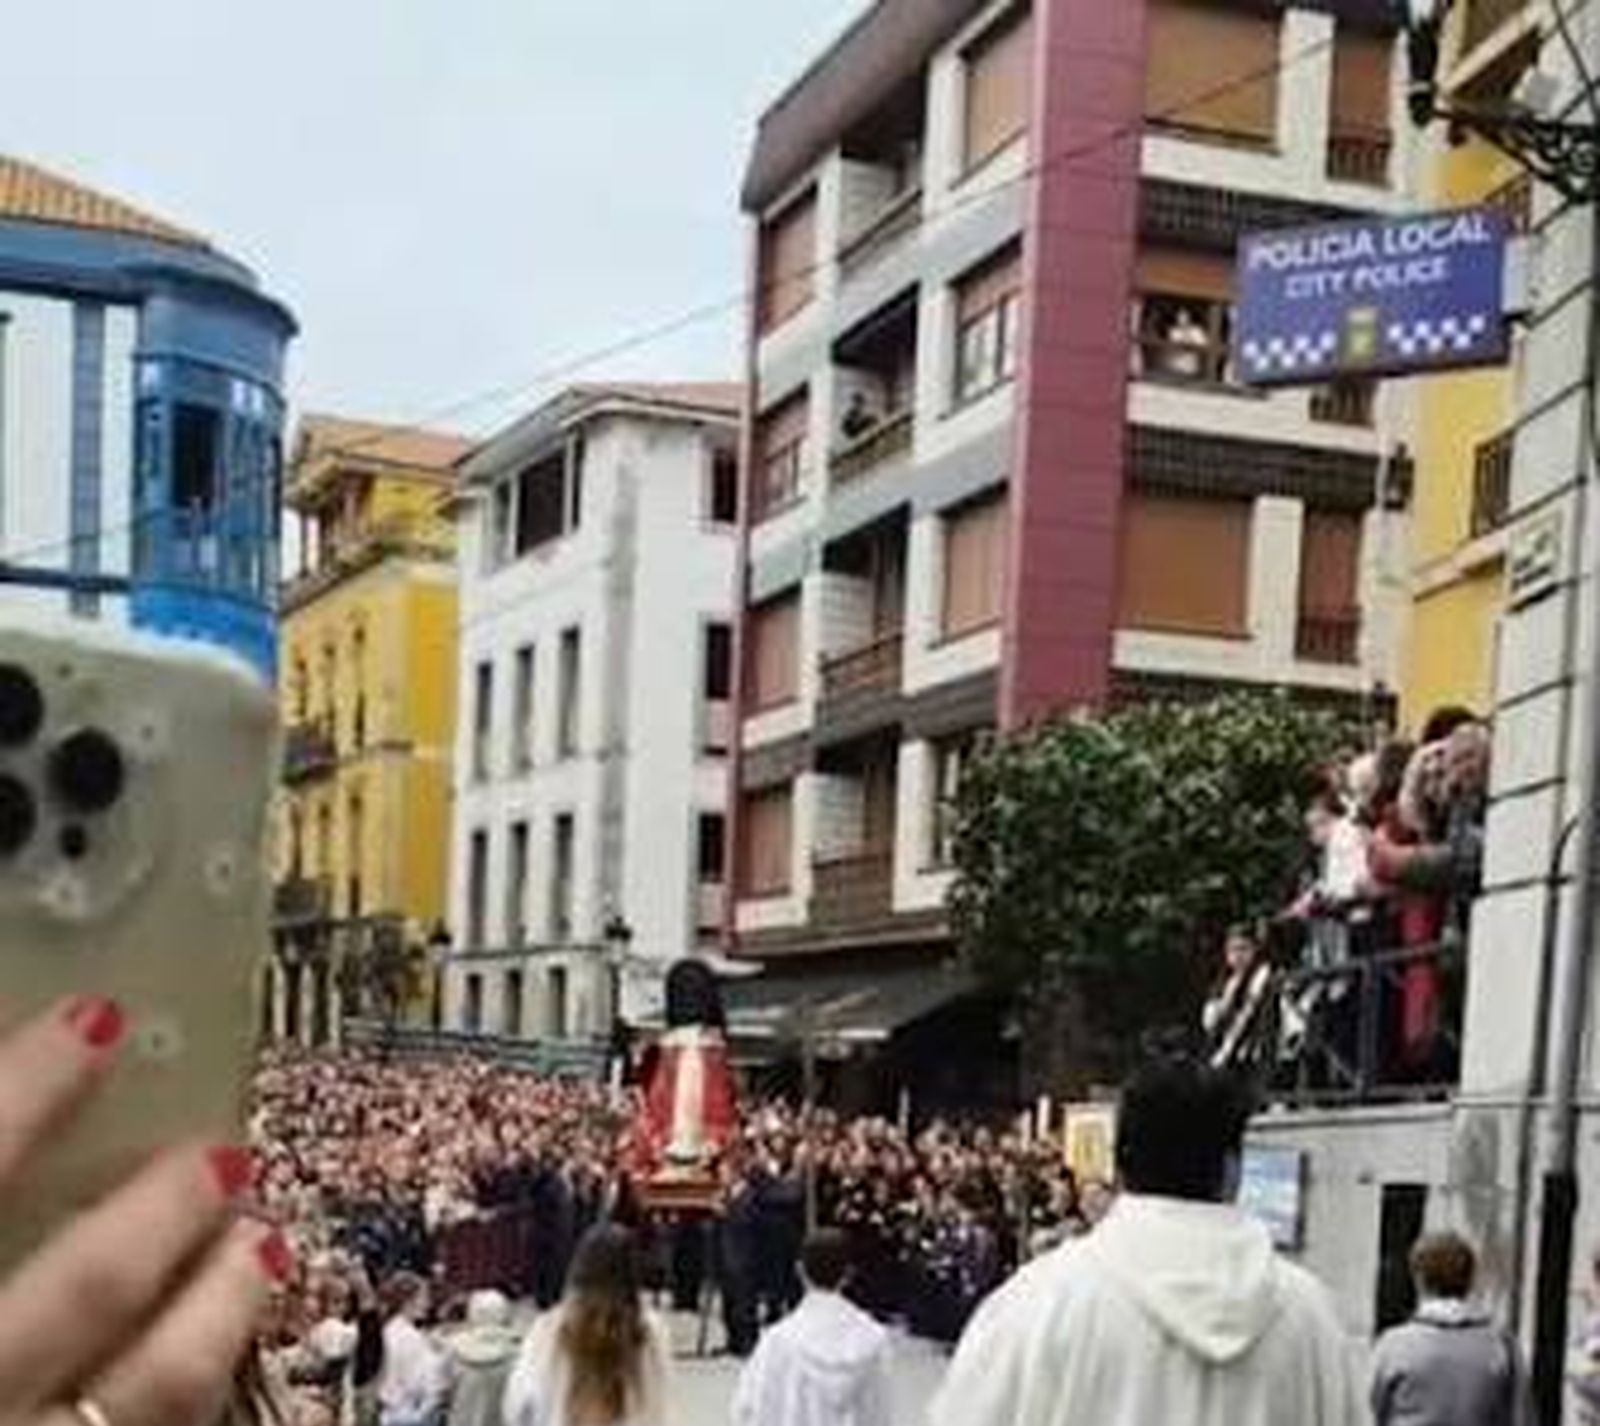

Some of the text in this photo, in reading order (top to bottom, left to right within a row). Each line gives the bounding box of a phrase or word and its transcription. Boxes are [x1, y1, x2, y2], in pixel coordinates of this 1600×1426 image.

[1383, 213, 1491, 256] LOCAL
[1285, 256, 1449, 299] CITY POLICE
